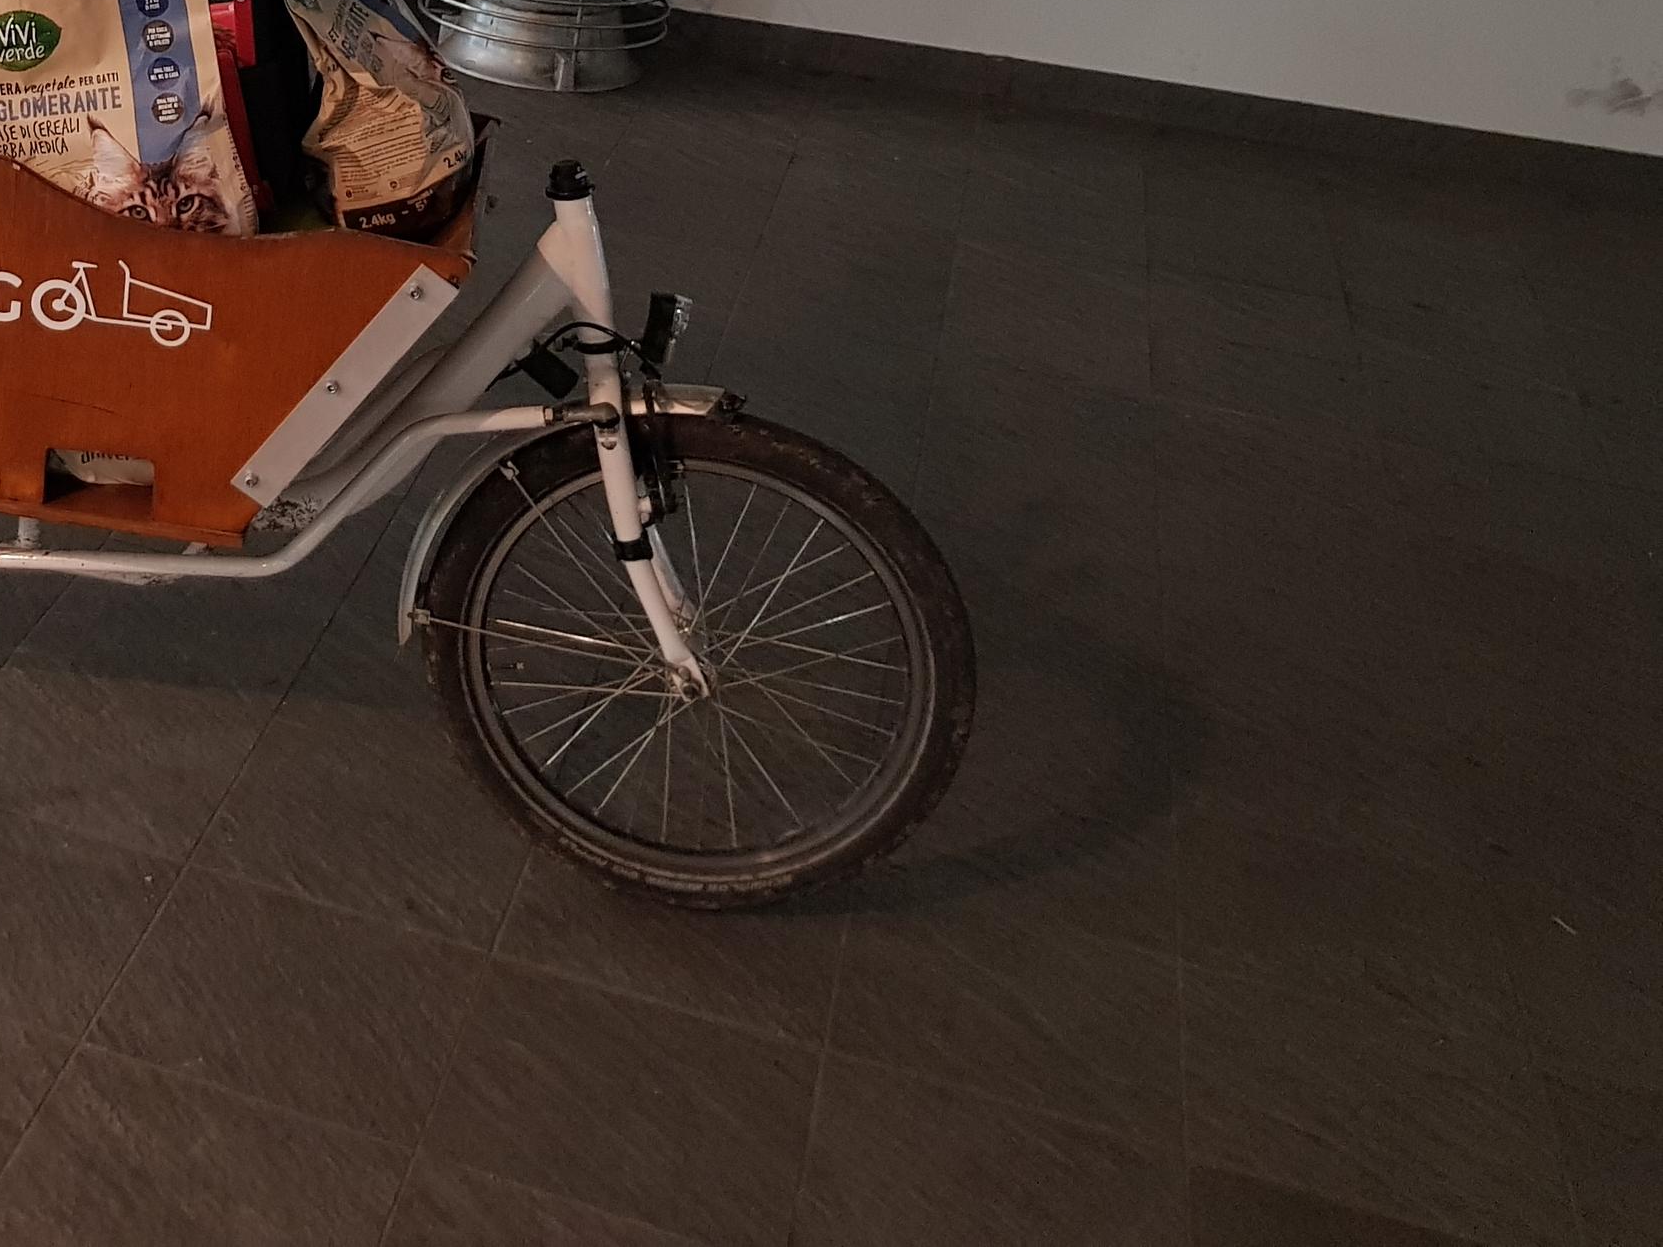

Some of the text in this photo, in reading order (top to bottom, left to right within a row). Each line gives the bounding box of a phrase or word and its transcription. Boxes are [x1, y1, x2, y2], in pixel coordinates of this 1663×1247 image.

[24, 76, 76, 95] vegetale
[79, 76, 94, 86] PER
[96, 72, 119, 85] GATTI
[20, 126, 31, 139] DI
[33, 117, 81, 140] CEREALI
[29, 137, 69, 155] MEDICA
[358, 213, 396, 229] 2.4kg
